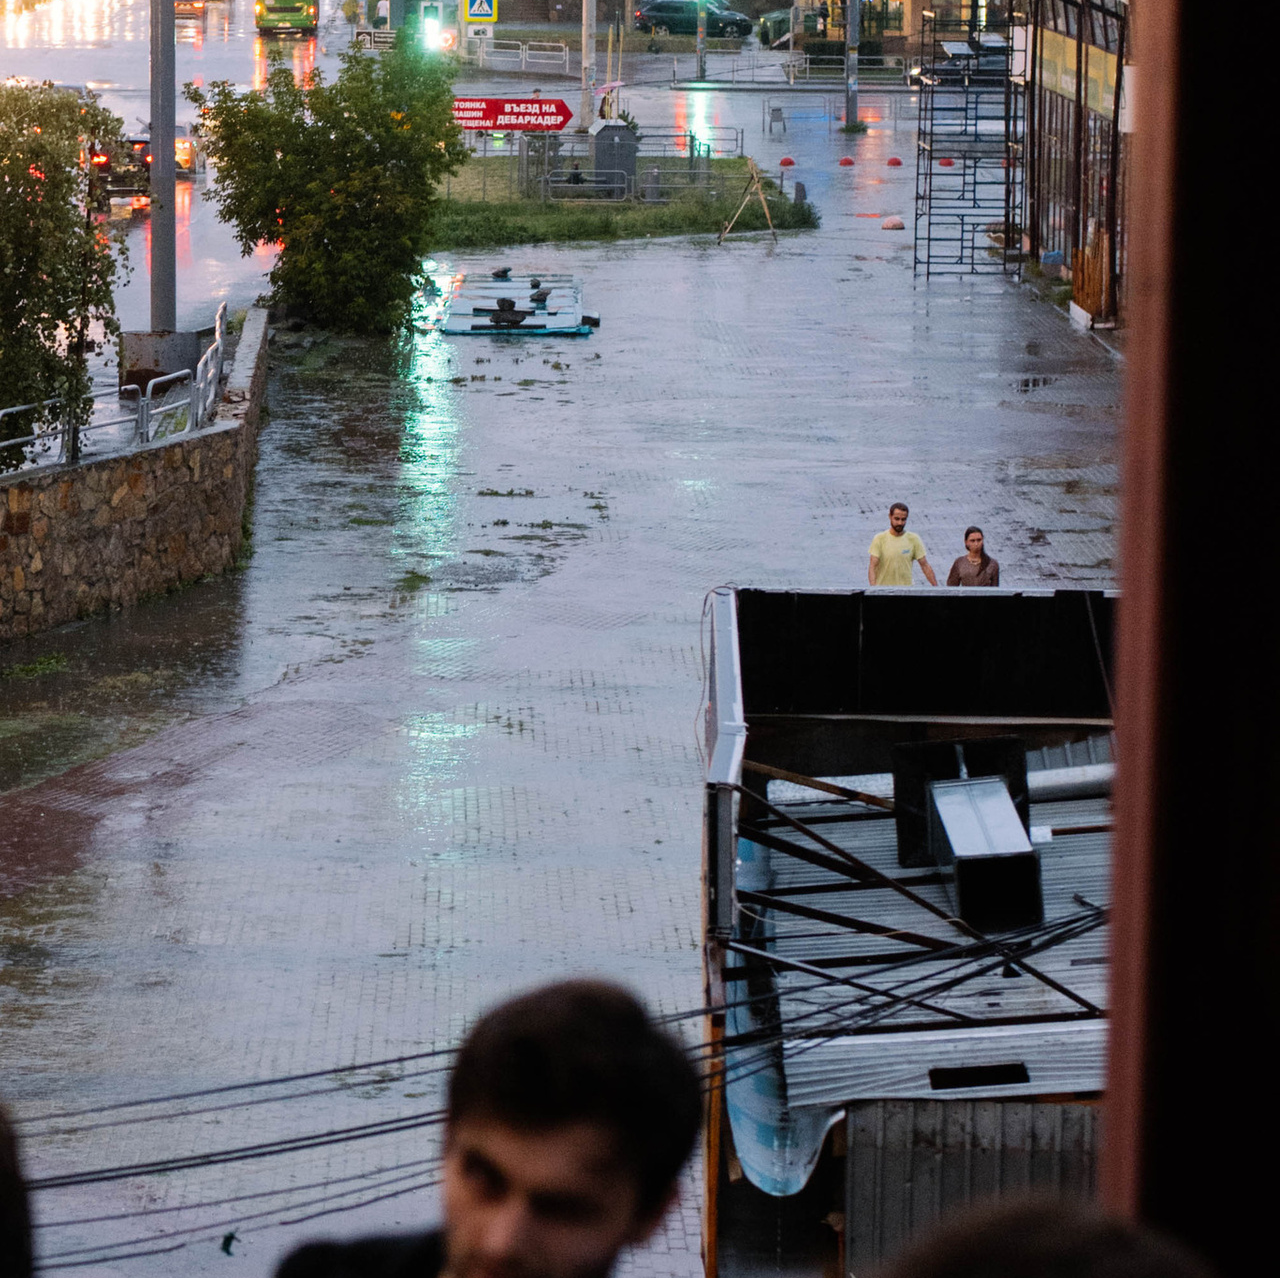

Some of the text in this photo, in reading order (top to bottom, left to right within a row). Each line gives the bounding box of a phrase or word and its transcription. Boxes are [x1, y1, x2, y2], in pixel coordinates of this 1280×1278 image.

[453, 101, 487, 109] ТОЯНКА
[504, 104, 557, 114] ВЪЕЗД НА
[496, 115, 564, 126] ДЕБАРКАДЕР
